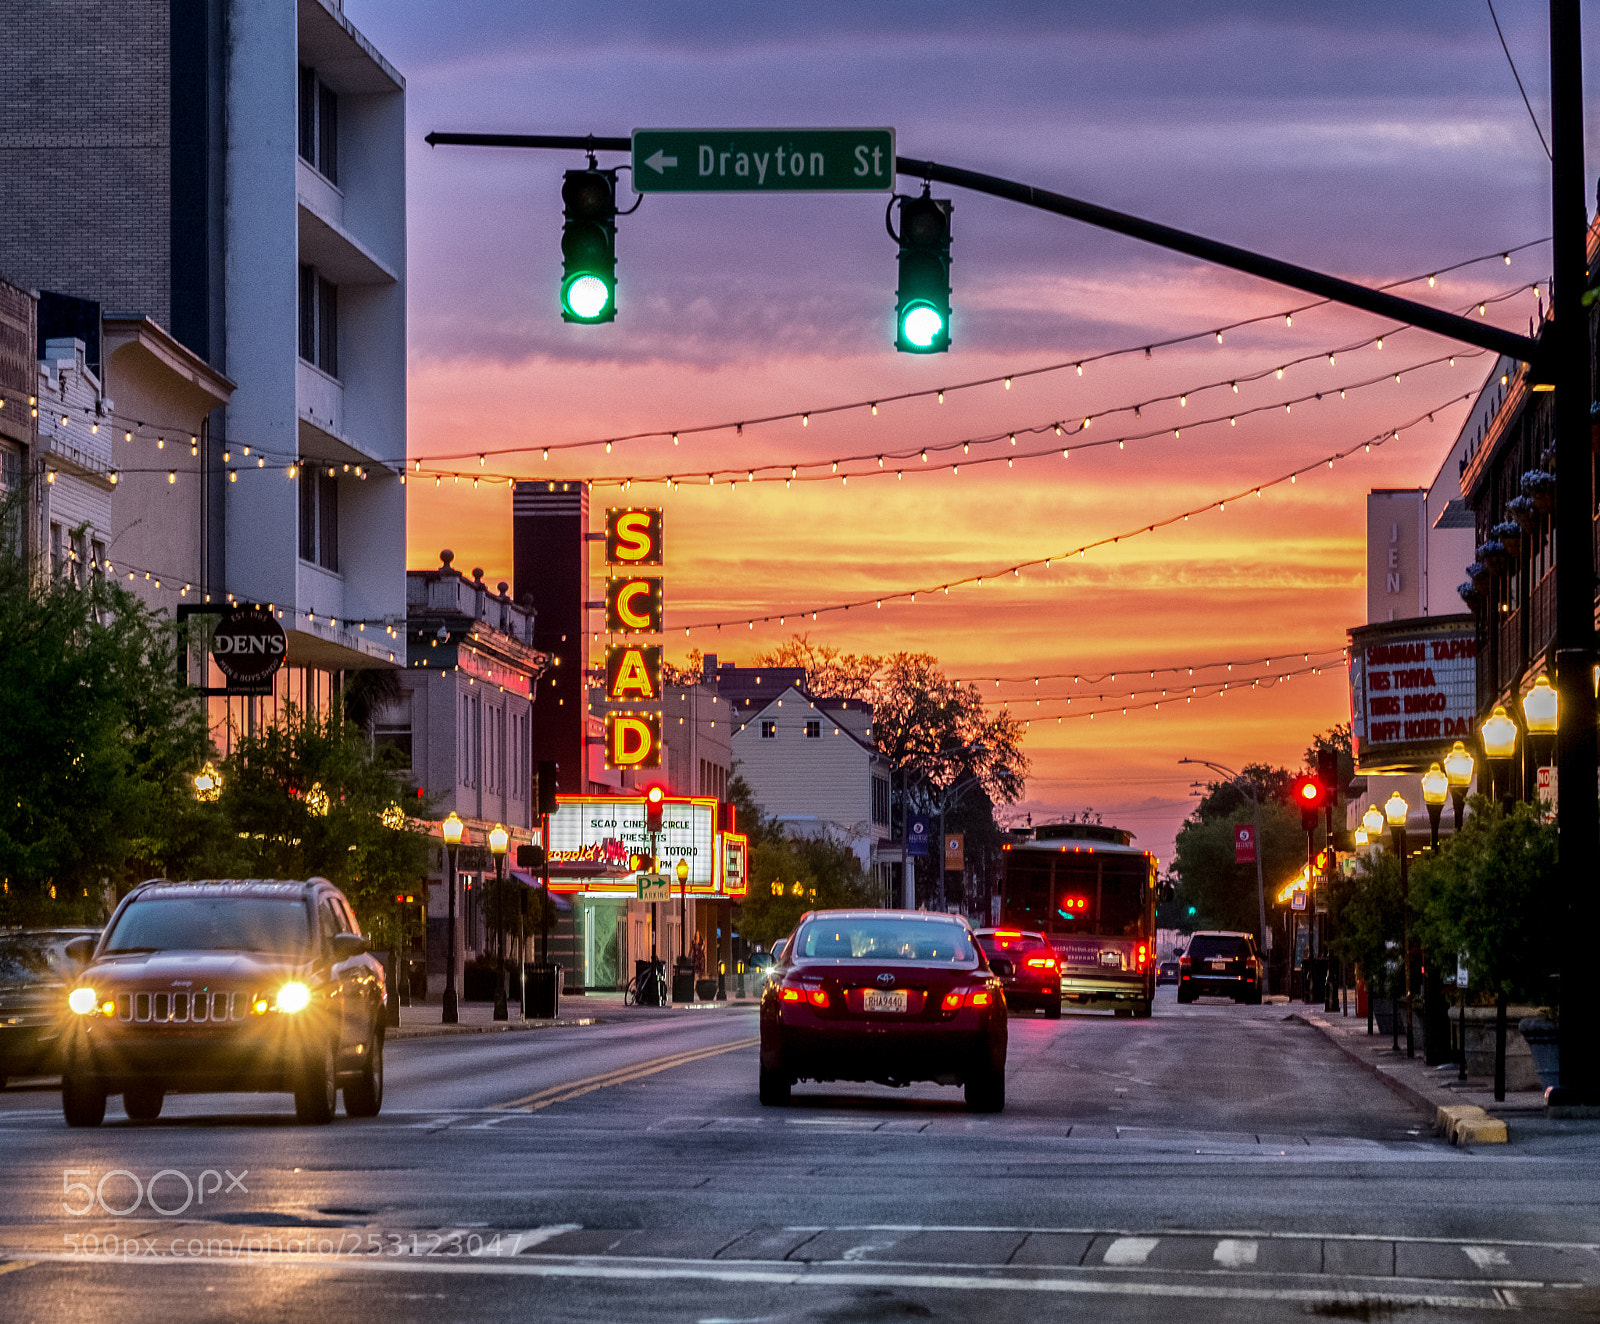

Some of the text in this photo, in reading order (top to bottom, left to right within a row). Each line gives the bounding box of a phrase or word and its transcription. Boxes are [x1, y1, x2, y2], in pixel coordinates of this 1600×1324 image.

[699, 145, 883, 185] Drayton St
[213, 635, 284, 654] DEN'S
[613, 512, 653, 764] SCAD
[1393, 668, 1436, 689] TRIVIA
[1404, 693, 1446, 714] BINGO
[1404, 719, 1440, 738] HOUR
[591, 820, 617, 828] SCAD
[661, 820, 690, 829] CIRCLE
[664, 847, 698, 856] TOTORO
[868, 996, 903, 1007] RHA9440
